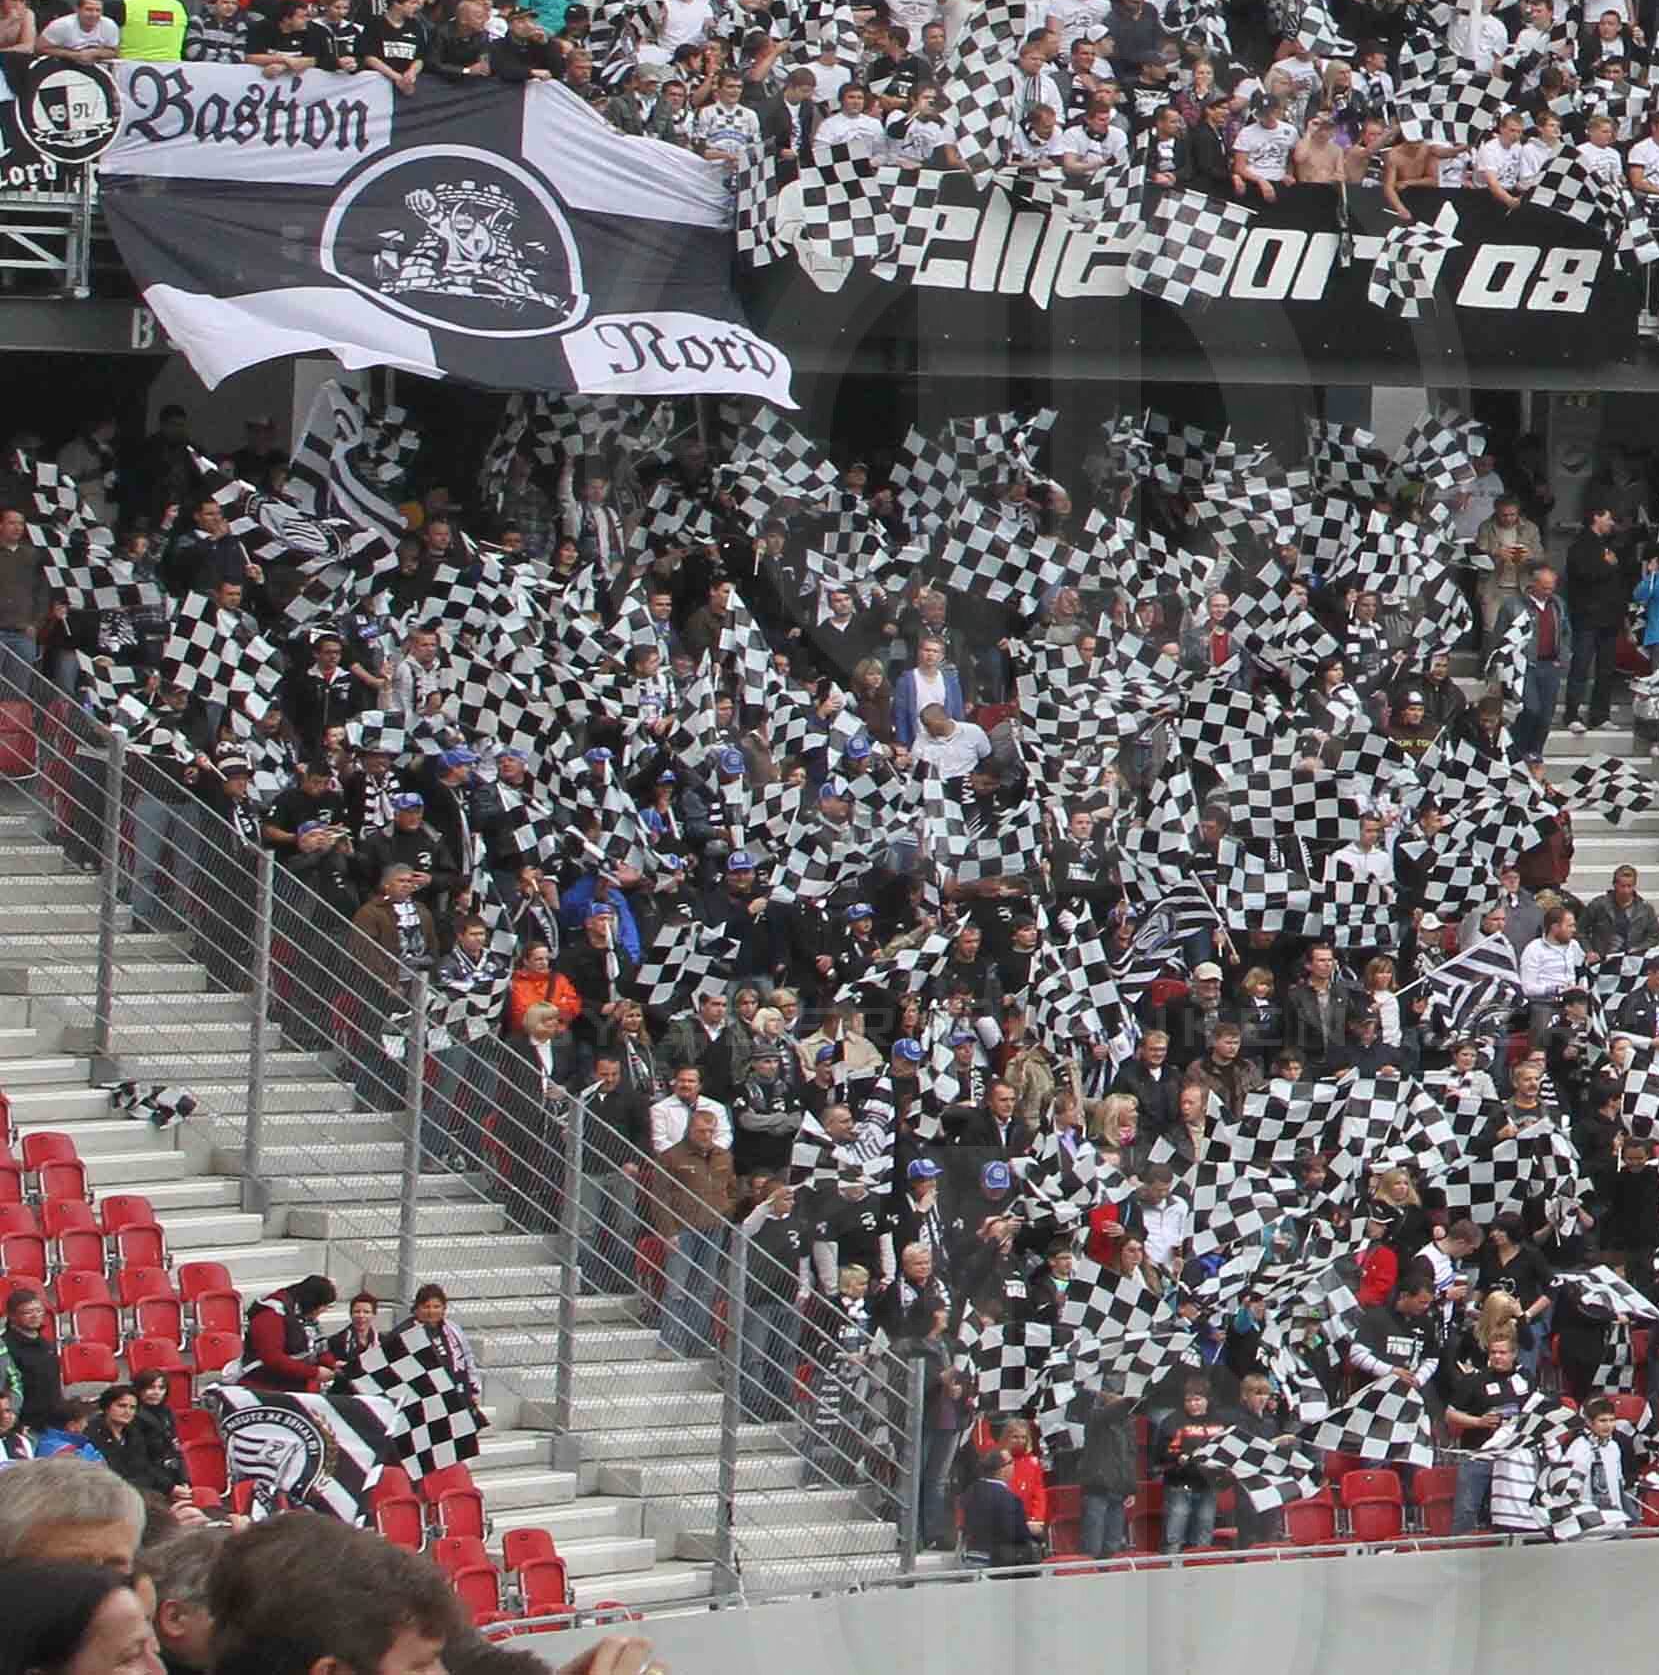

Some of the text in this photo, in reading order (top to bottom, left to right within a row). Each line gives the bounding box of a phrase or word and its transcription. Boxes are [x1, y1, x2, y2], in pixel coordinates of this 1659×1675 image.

[125, 64, 370, 152] Bastion
[1456, 243, 1603, 313] 08
[597, 322, 777, 379] Nord
